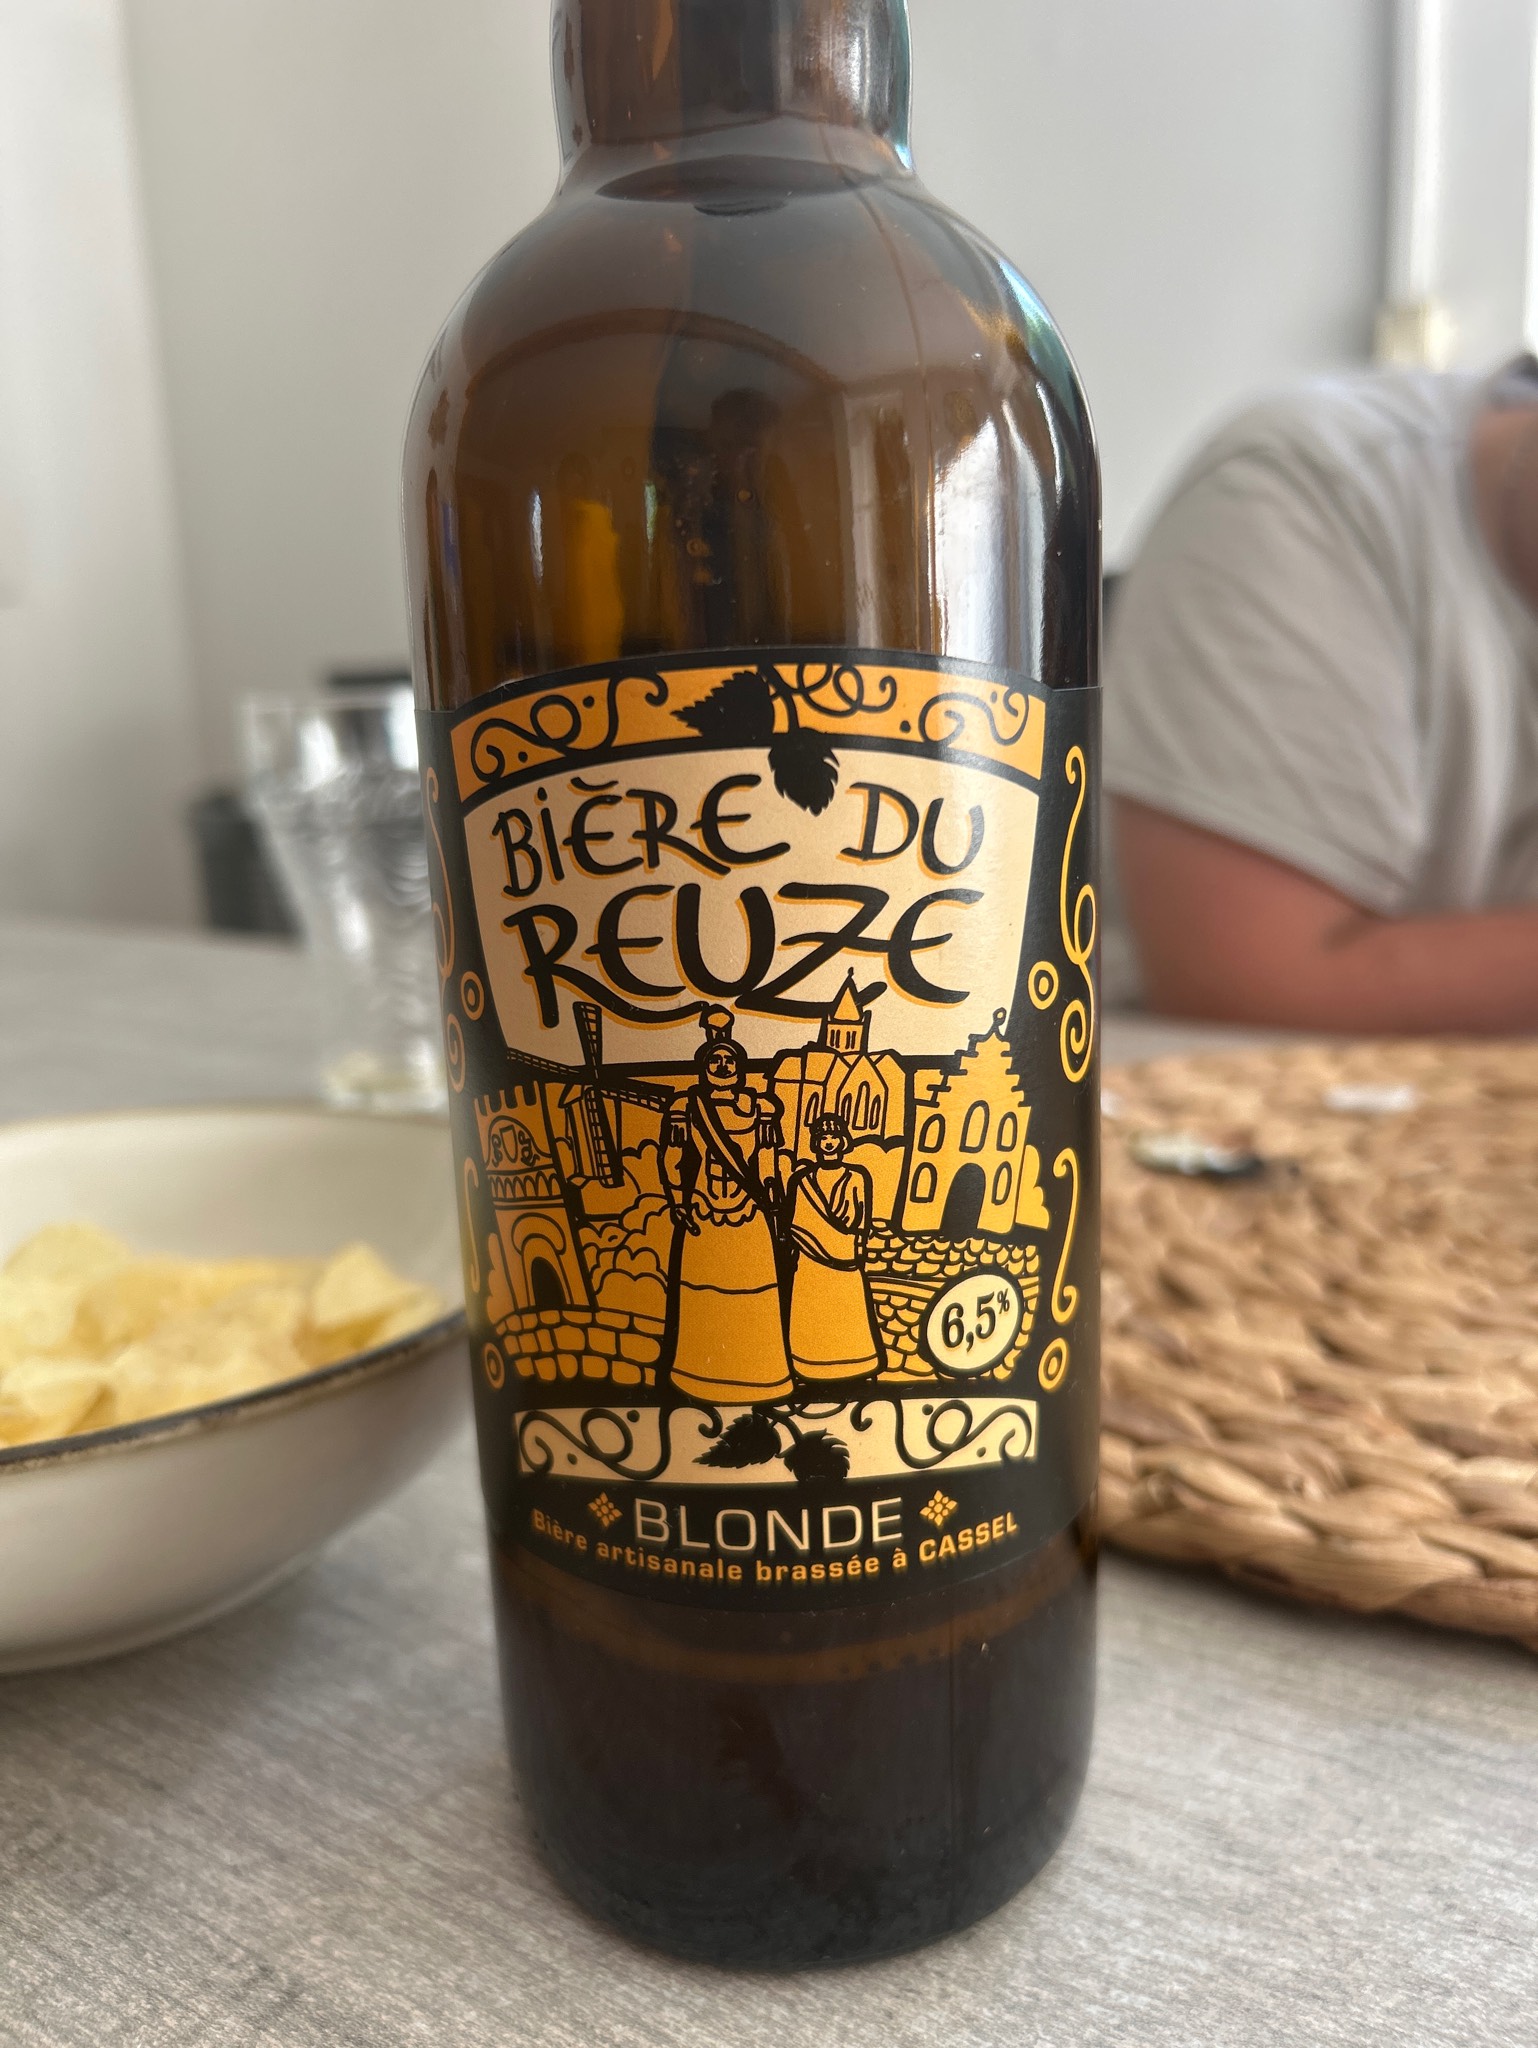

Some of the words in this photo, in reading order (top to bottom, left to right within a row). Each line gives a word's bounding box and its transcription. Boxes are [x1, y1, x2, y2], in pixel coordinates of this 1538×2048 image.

[839, 781, 985, 876] DU
[502, 882, 985, 1029] REUZE
[941, 1288, 1011, 1355] 6,5%
[531, 1507, 589, 1551] Bière
[595, 1540, 742, 1581] artisanale
[755, 1552, 880, 1582] brassée
[892, 1546, 908, 1569] à
[918, 1510, 1019, 1564] CASSEL
[634, 1496, 903, 1551] BLONDE
